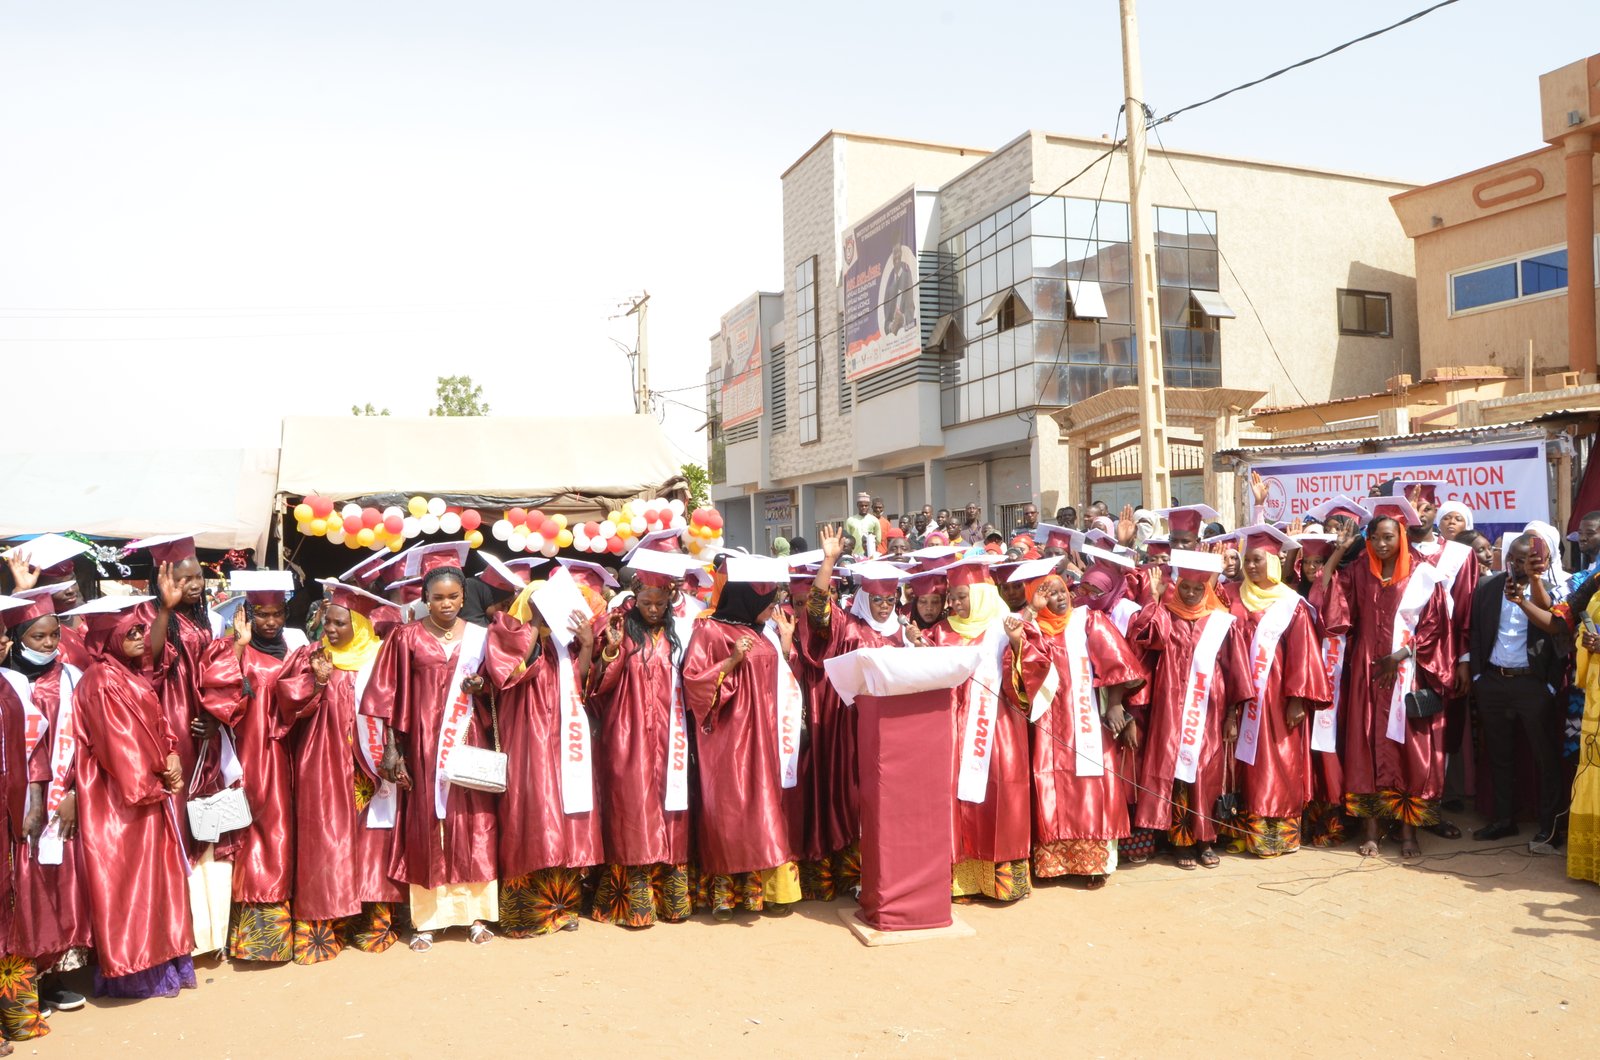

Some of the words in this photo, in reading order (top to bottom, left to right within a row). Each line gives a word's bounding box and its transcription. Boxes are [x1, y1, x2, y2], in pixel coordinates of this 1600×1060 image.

[1296, 474, 1366, 493] INSTITUT
[1291, 498, 1309, 514] EN
[1183, 671, 1207, 746] IFSS
